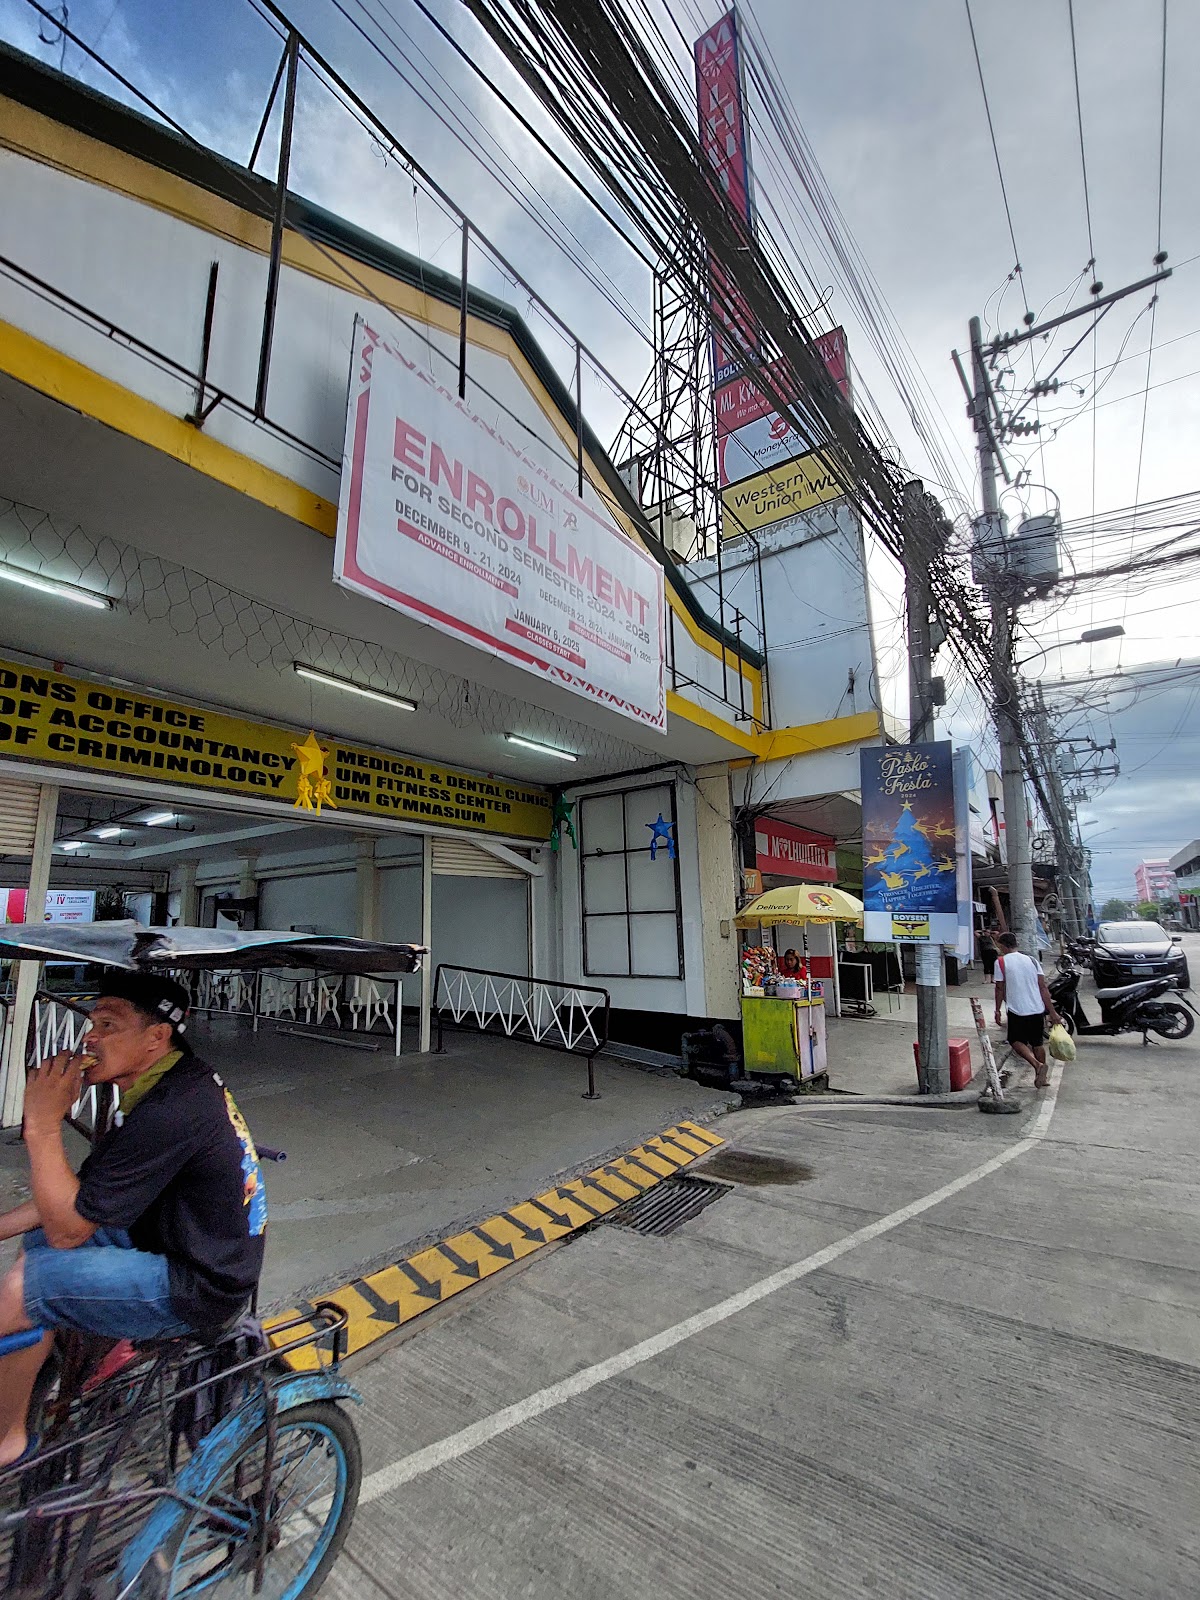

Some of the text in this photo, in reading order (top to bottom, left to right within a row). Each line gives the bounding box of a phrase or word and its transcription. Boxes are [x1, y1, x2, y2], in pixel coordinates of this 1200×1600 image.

[529, 483, 555, 514] UM
[735, 474, 803, 507] Western
[755, 489, 802, 515] Union
[393, 416, 649, 627] ENROLLMENT
[395, 499, 461, 549] DECEMBER
[464, 541, 470, 555] 9
[480, 552, 495, 572] 21,
[499, 563, 522, 585] 2024
[391, 464, 433, 504] FOR
[438, 495, 509, 553] SECOND
[512, 546, 584, 601] SEMESTER
[587, 594, 615, 621] 2024
[625, 619, 650, 644] 2025
[417, 533, 505, 589] ADVANCE ENROLLMENT
[514, 608, 580, 653] JANUARY 6, 2025
[539, 589, 576, 619] DECEMBER
[607, 630, 632, 653] JANUARY
[526, 631, 571, 660] CLASSES START
[87, 691, 205, 733] OFFICE
[47, 732, 285, 789] CRIMINOLOGY
[48, 707, 298, 771] ACCOUNTANCY
[336, 749, 550, 808] MEDICAL & DENTAL CLINIC
[881, 753, 929, 778] Pasko
[884, 773, 932, 795] Fiesta
[335, 785, 486, 824] UM GYMNASIUM
[336, 767, 512, 814] UM FITNESS CENTER
